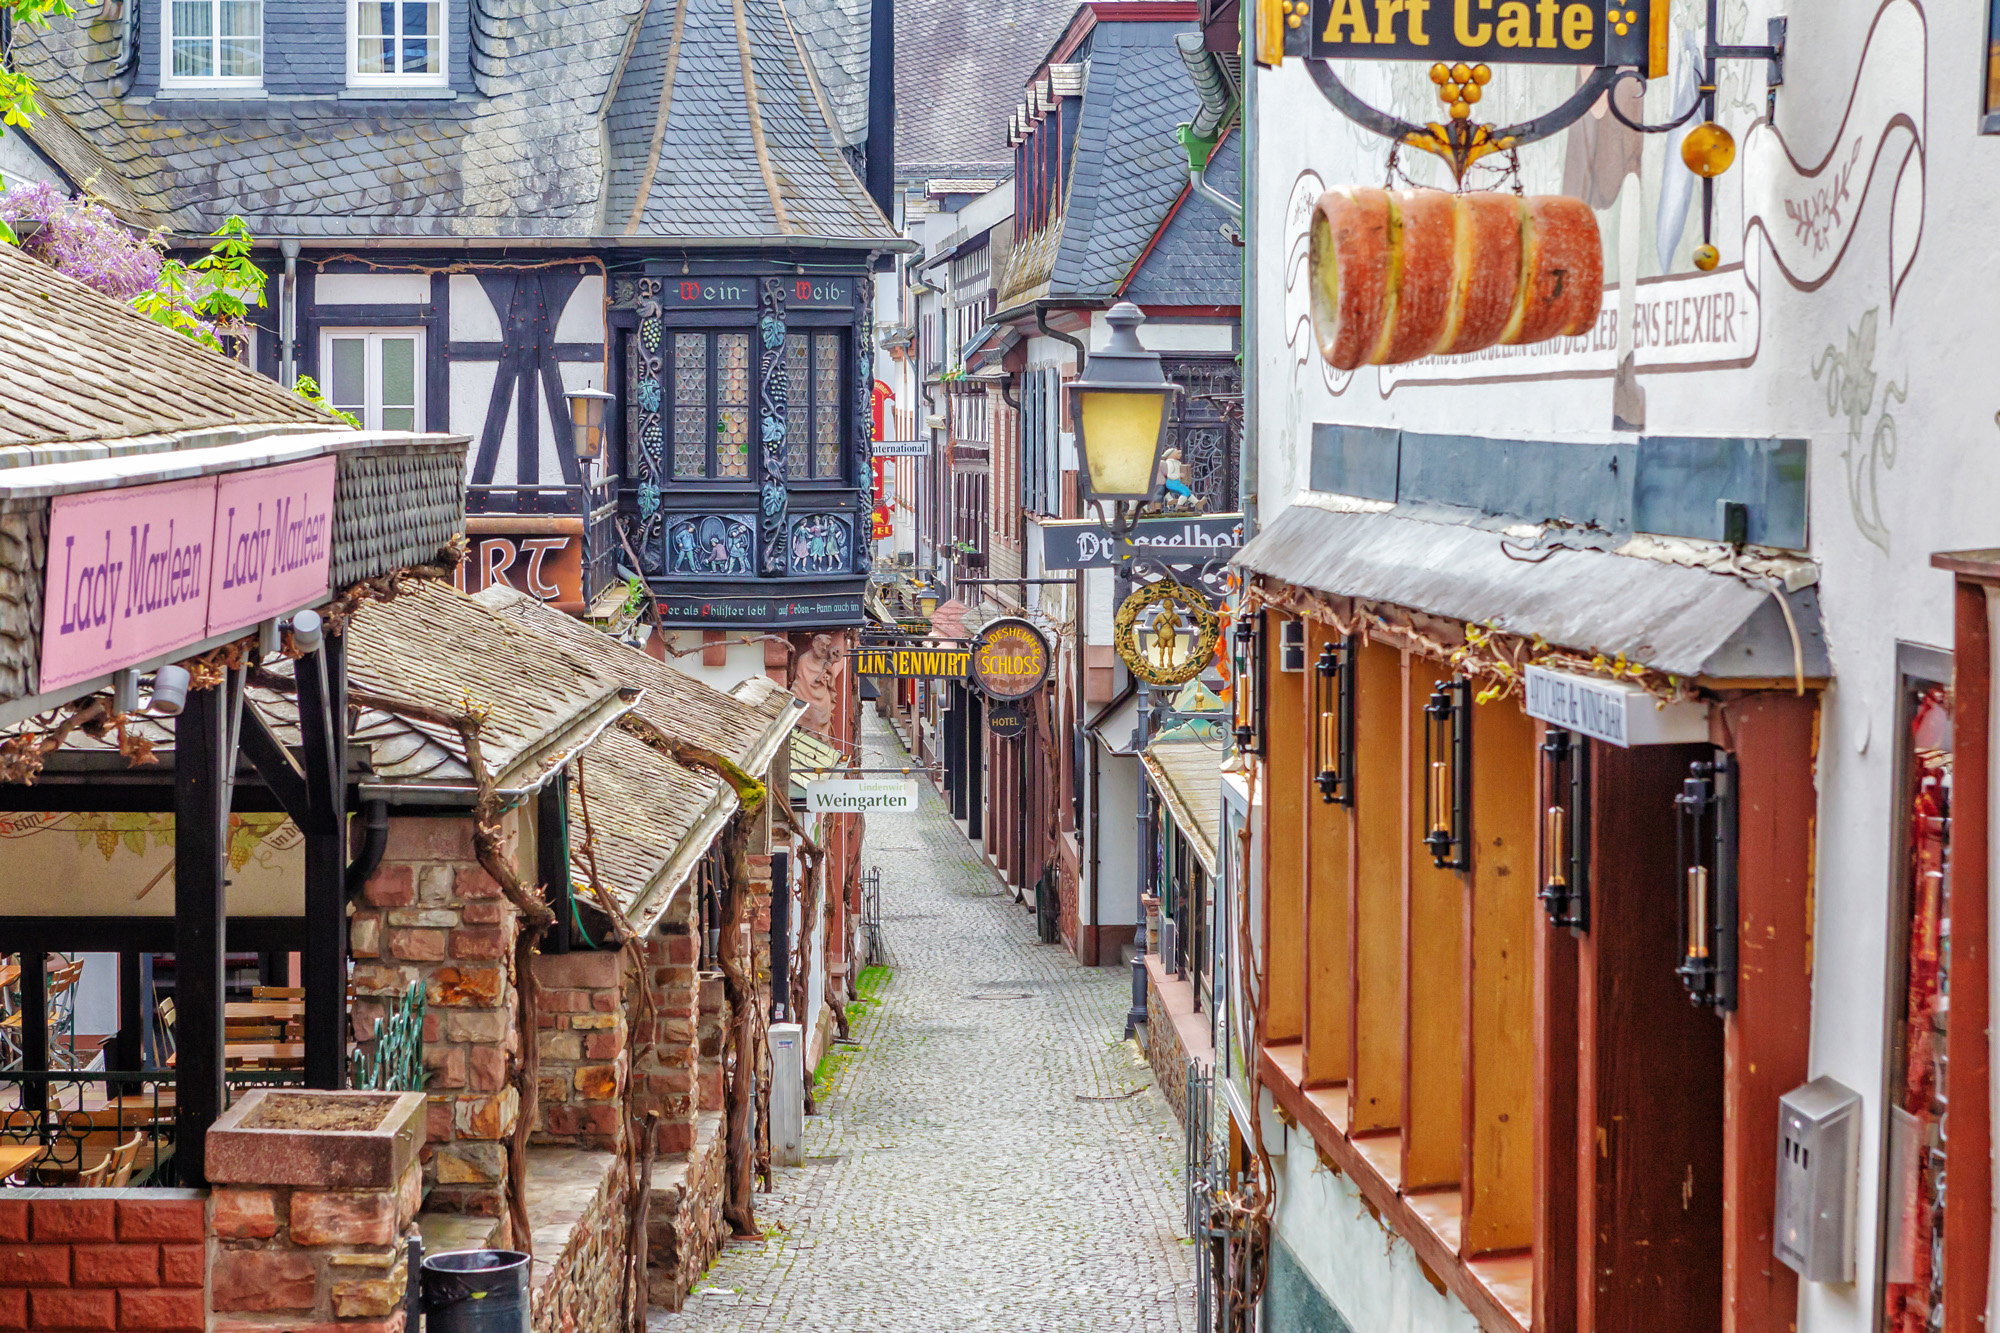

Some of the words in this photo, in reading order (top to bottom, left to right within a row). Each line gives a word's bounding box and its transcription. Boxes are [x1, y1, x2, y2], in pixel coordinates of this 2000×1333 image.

[1322, 0, 1430, 46] Art
[1664, 292, 1737, 347] ELEXIER
[873, 443, 925, 454] nternational
[222, 502, 272, 602] Lady
[271, 493, 326, 576] Marleen
[60, 530, 123, 649] Lady
[124, 519, 201, 618] Marleen
[658, 603, 680, 615] Wer
[683, 604, 699, 615] als
[747, 604, 767, 616] lebt
[778, 604, 789, 616] auf
[833, 601, 850, 613] auch
[981, 655, 1040, 675] SCHLOSS
[991, 717, 1020, 727] HOTEL
[816, 793, 907, 811] Weingarten
